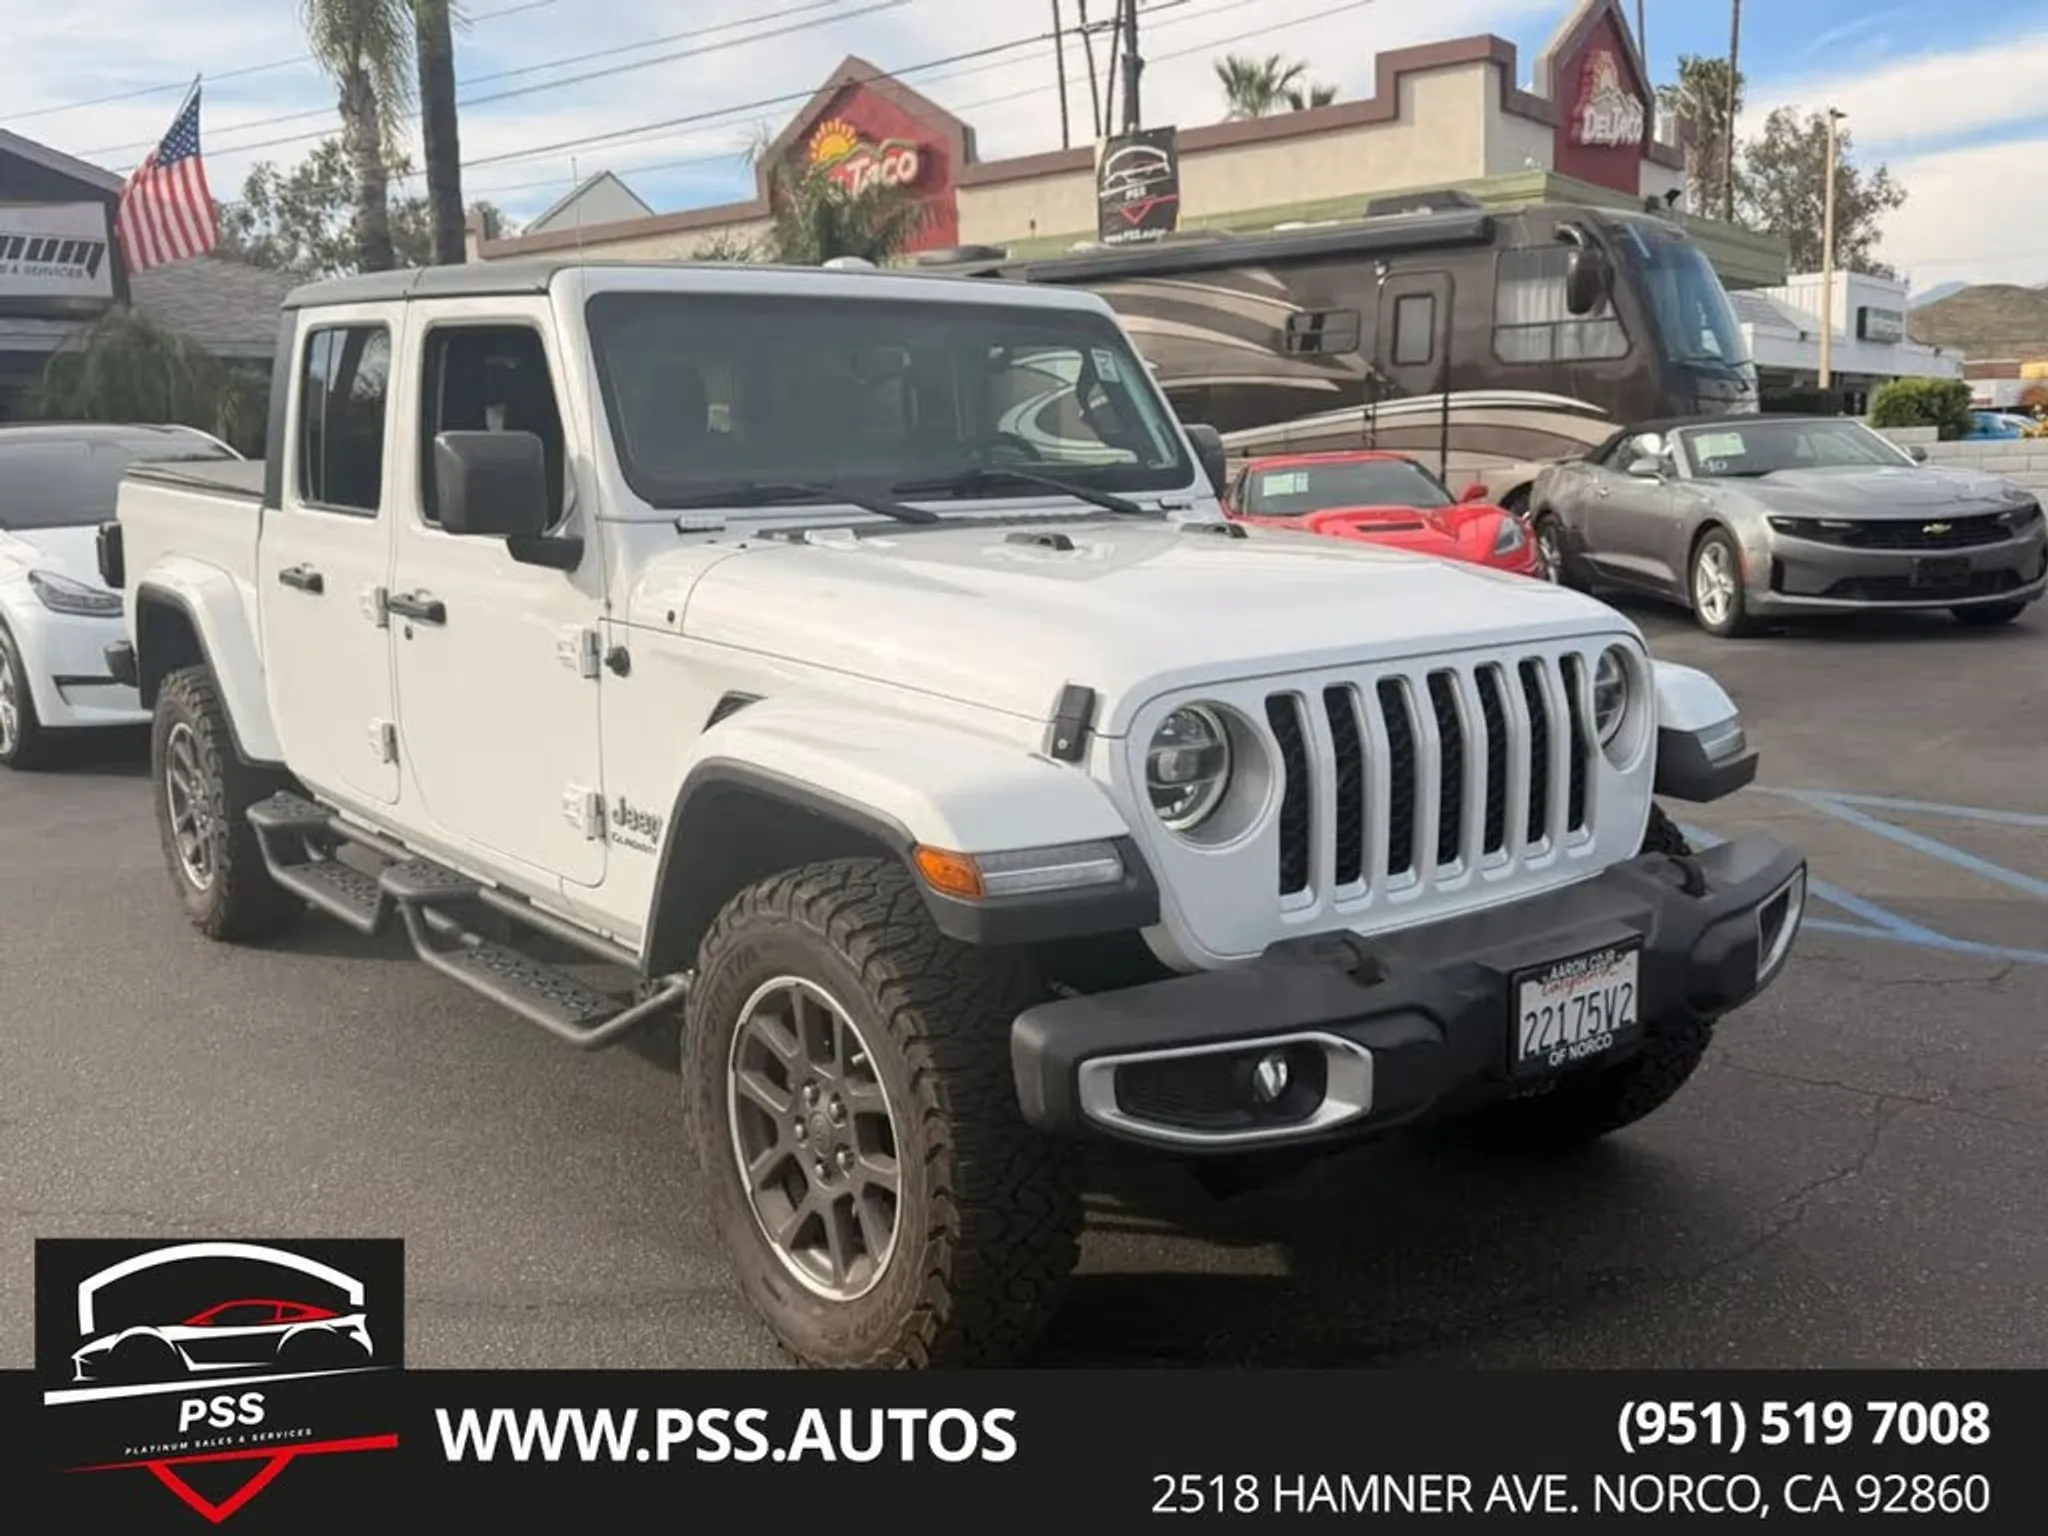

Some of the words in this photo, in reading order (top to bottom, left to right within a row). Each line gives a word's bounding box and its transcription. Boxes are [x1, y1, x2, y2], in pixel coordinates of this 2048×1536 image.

[612, 795, 663, 845] Jeep
[1523, 982, 1633, 1058] 22175V2
[1548, 1049, 1566, 1067] OF
[1567, 1033, 1614, 1061] NORCO
